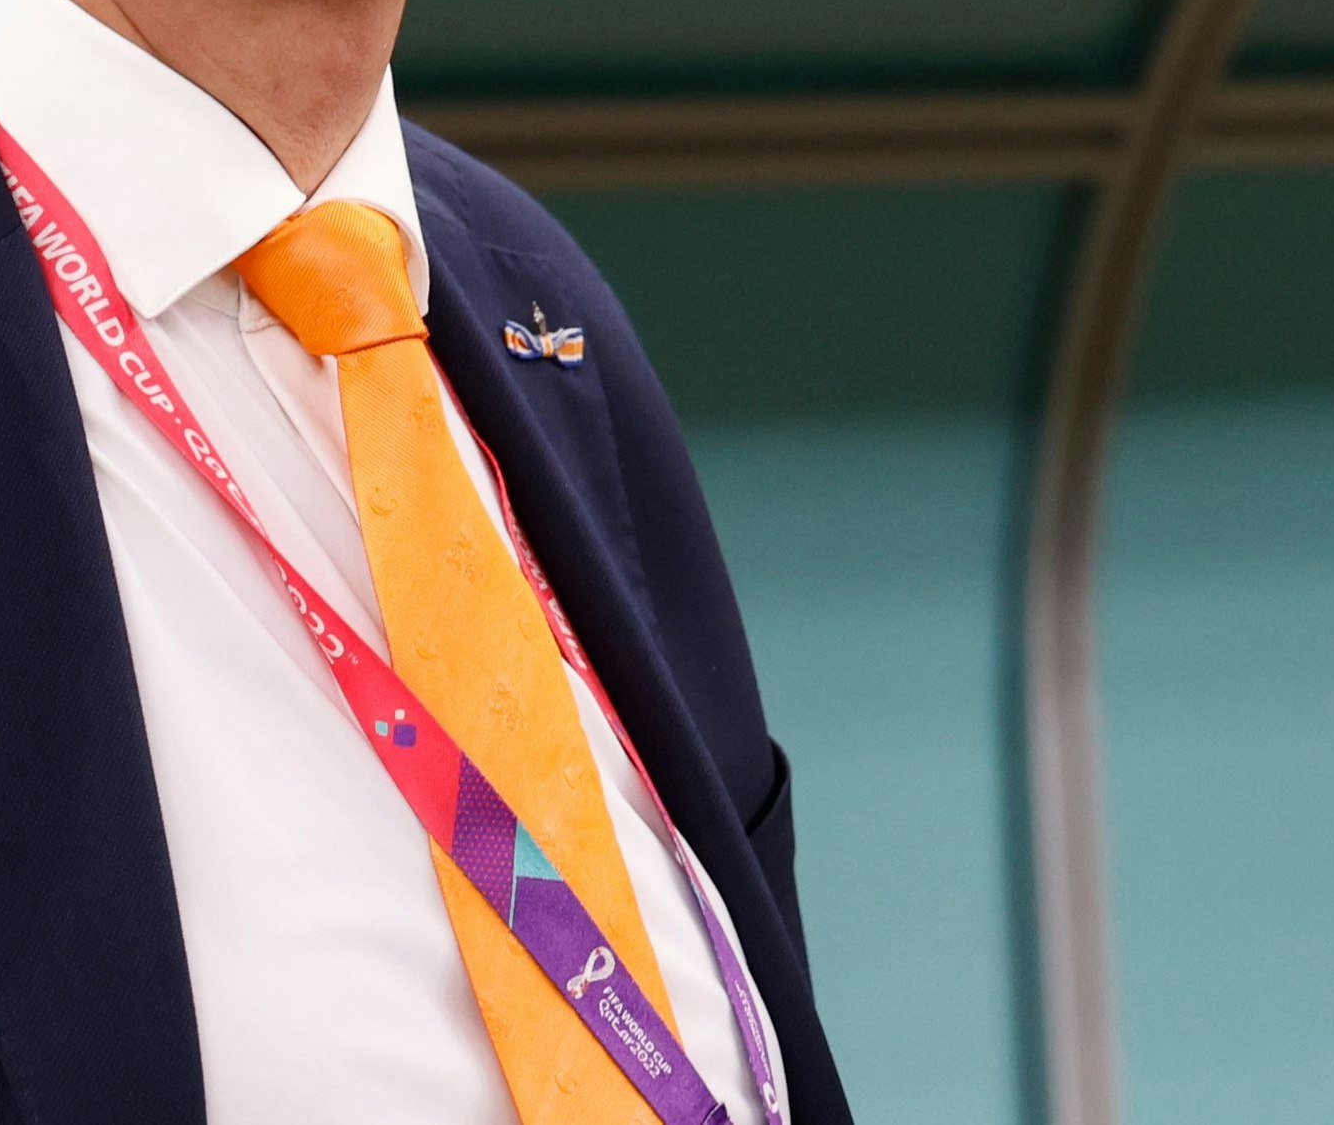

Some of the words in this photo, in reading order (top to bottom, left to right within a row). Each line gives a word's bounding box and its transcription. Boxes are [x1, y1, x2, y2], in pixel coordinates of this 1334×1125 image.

[33, 221, 126, 347] WORLD
[119, 350, 174, 414] CUP
[603, 986, 625, 1015] FIFA
[620, 1008, 655, 1053] WORLD
[653, 1050, 672, 1074] CUP
